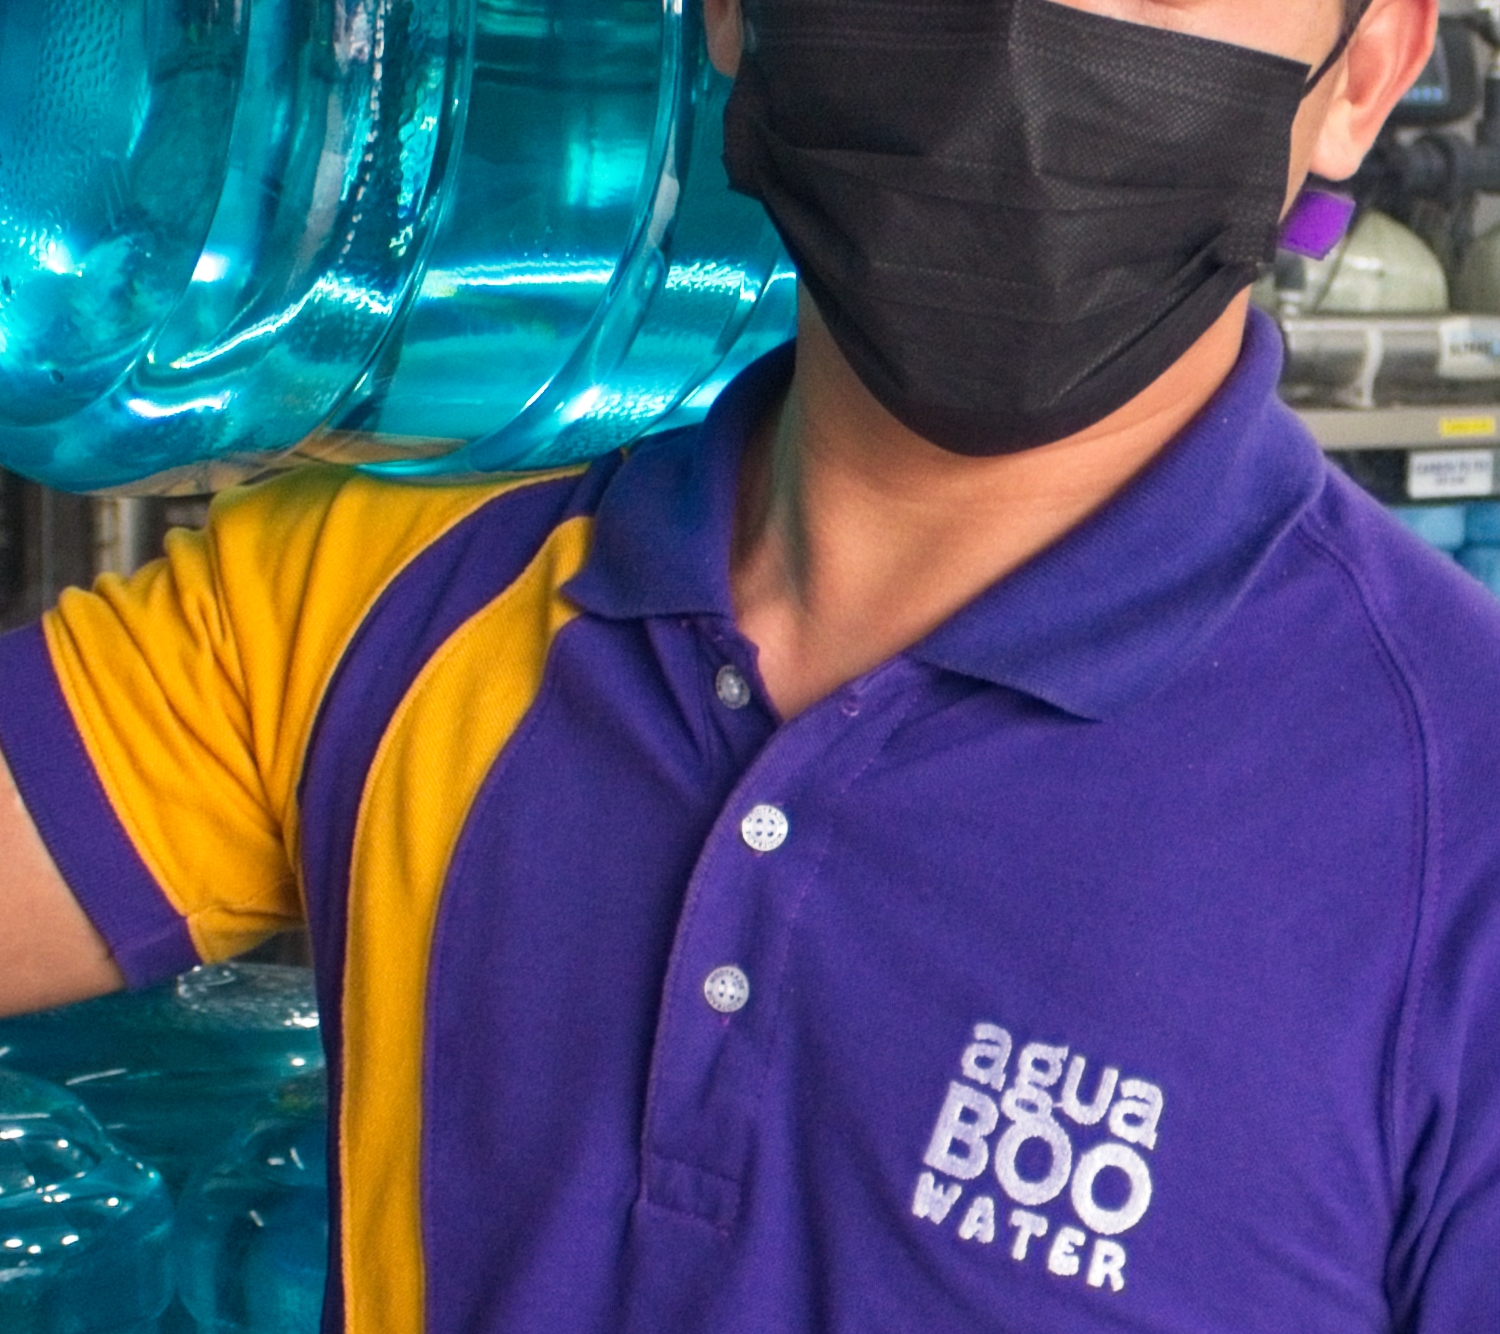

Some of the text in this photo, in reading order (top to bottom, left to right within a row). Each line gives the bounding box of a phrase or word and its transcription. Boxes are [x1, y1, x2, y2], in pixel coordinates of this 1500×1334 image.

[961, 1022, 1164, 1151] agua
[923, 1080, 1152, 1236] BOO
[912, 1171, 1127, 1292] WATER
